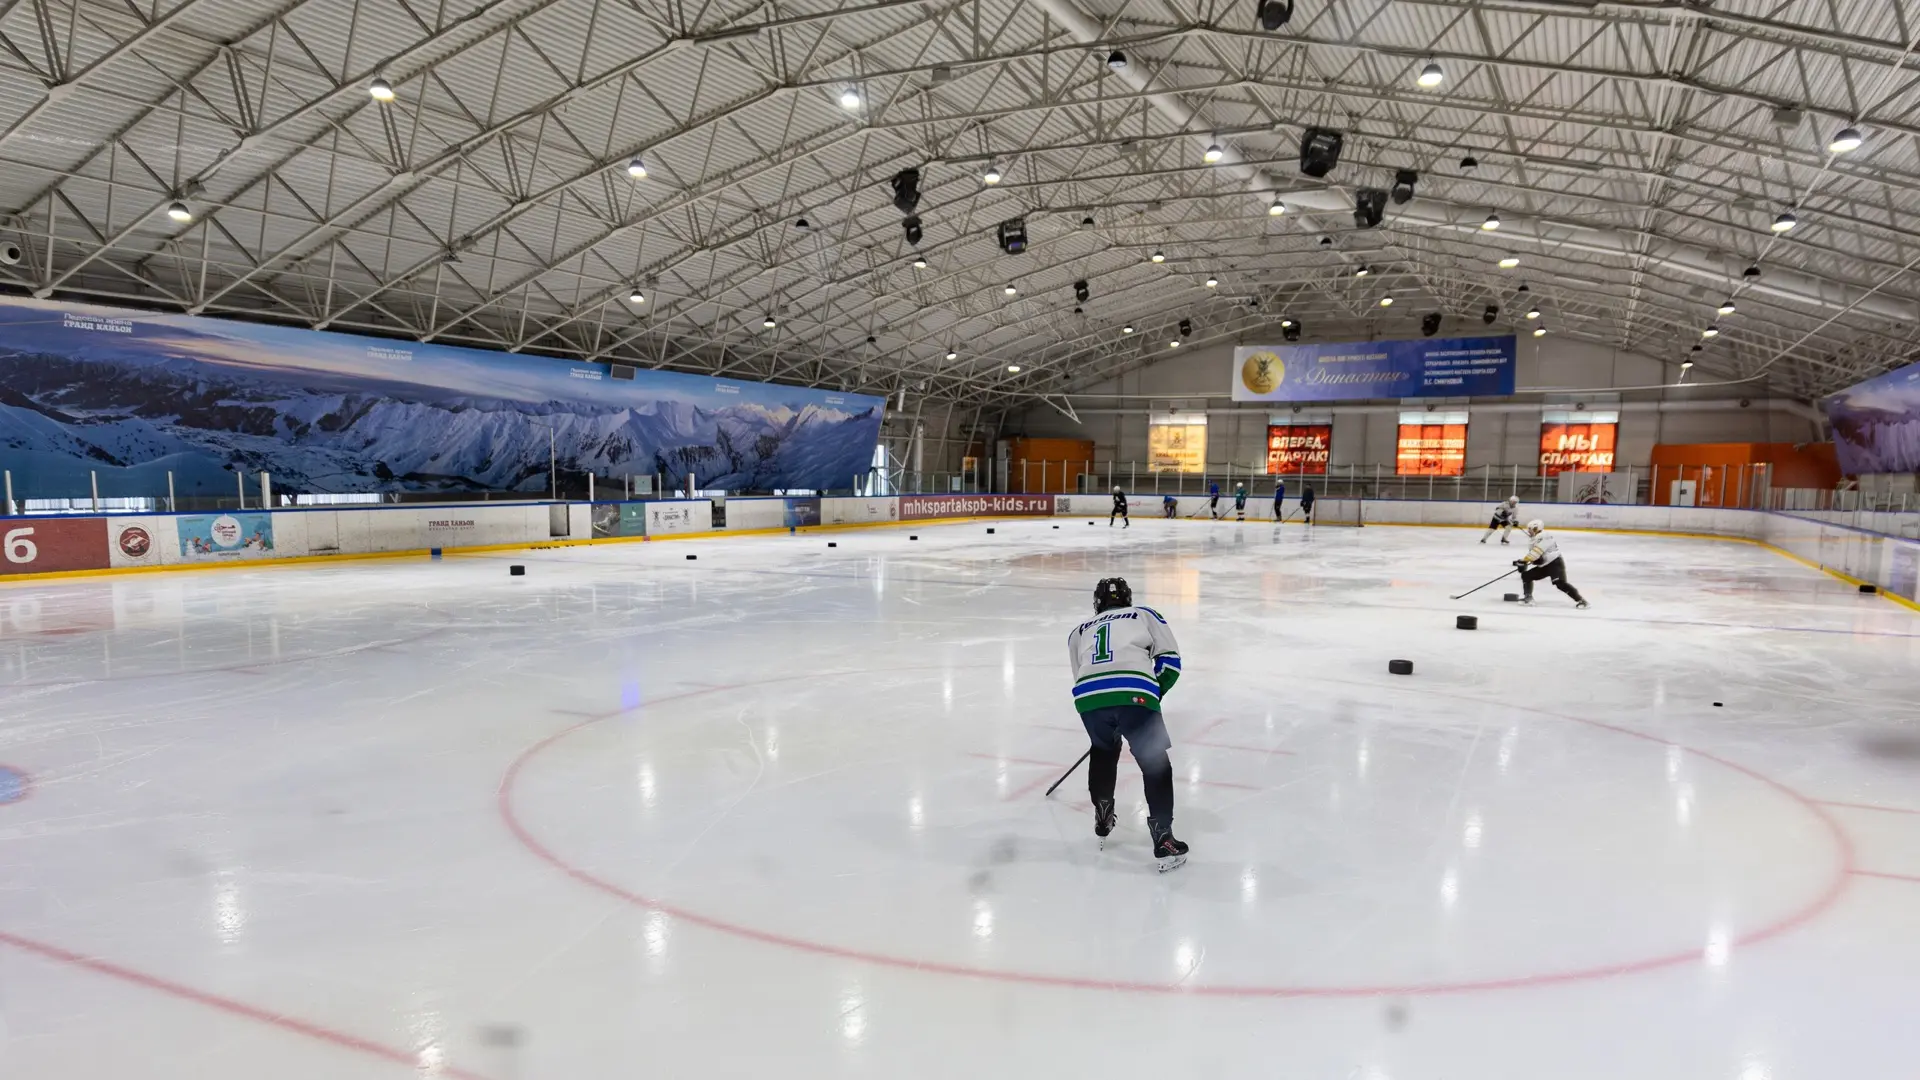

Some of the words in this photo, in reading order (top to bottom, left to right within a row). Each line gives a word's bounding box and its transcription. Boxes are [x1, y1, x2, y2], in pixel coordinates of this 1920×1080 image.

[64, 320, 94, 330] ГРАНД
[96, 323, 132, 333] КАНЬОН
[1271, 435, 1326, 450] ВПЕРЕД,
[1558, 434, 1599, 451] МЫ
[1269, 450, 1329, 462] СПАРТАК!
[1541, 452, 1614, 465] СПАРТАК!
[903, 496, 1048, 515] mhkspartakspb-kids.ru
[1092, 622, 1113, 664] 1
